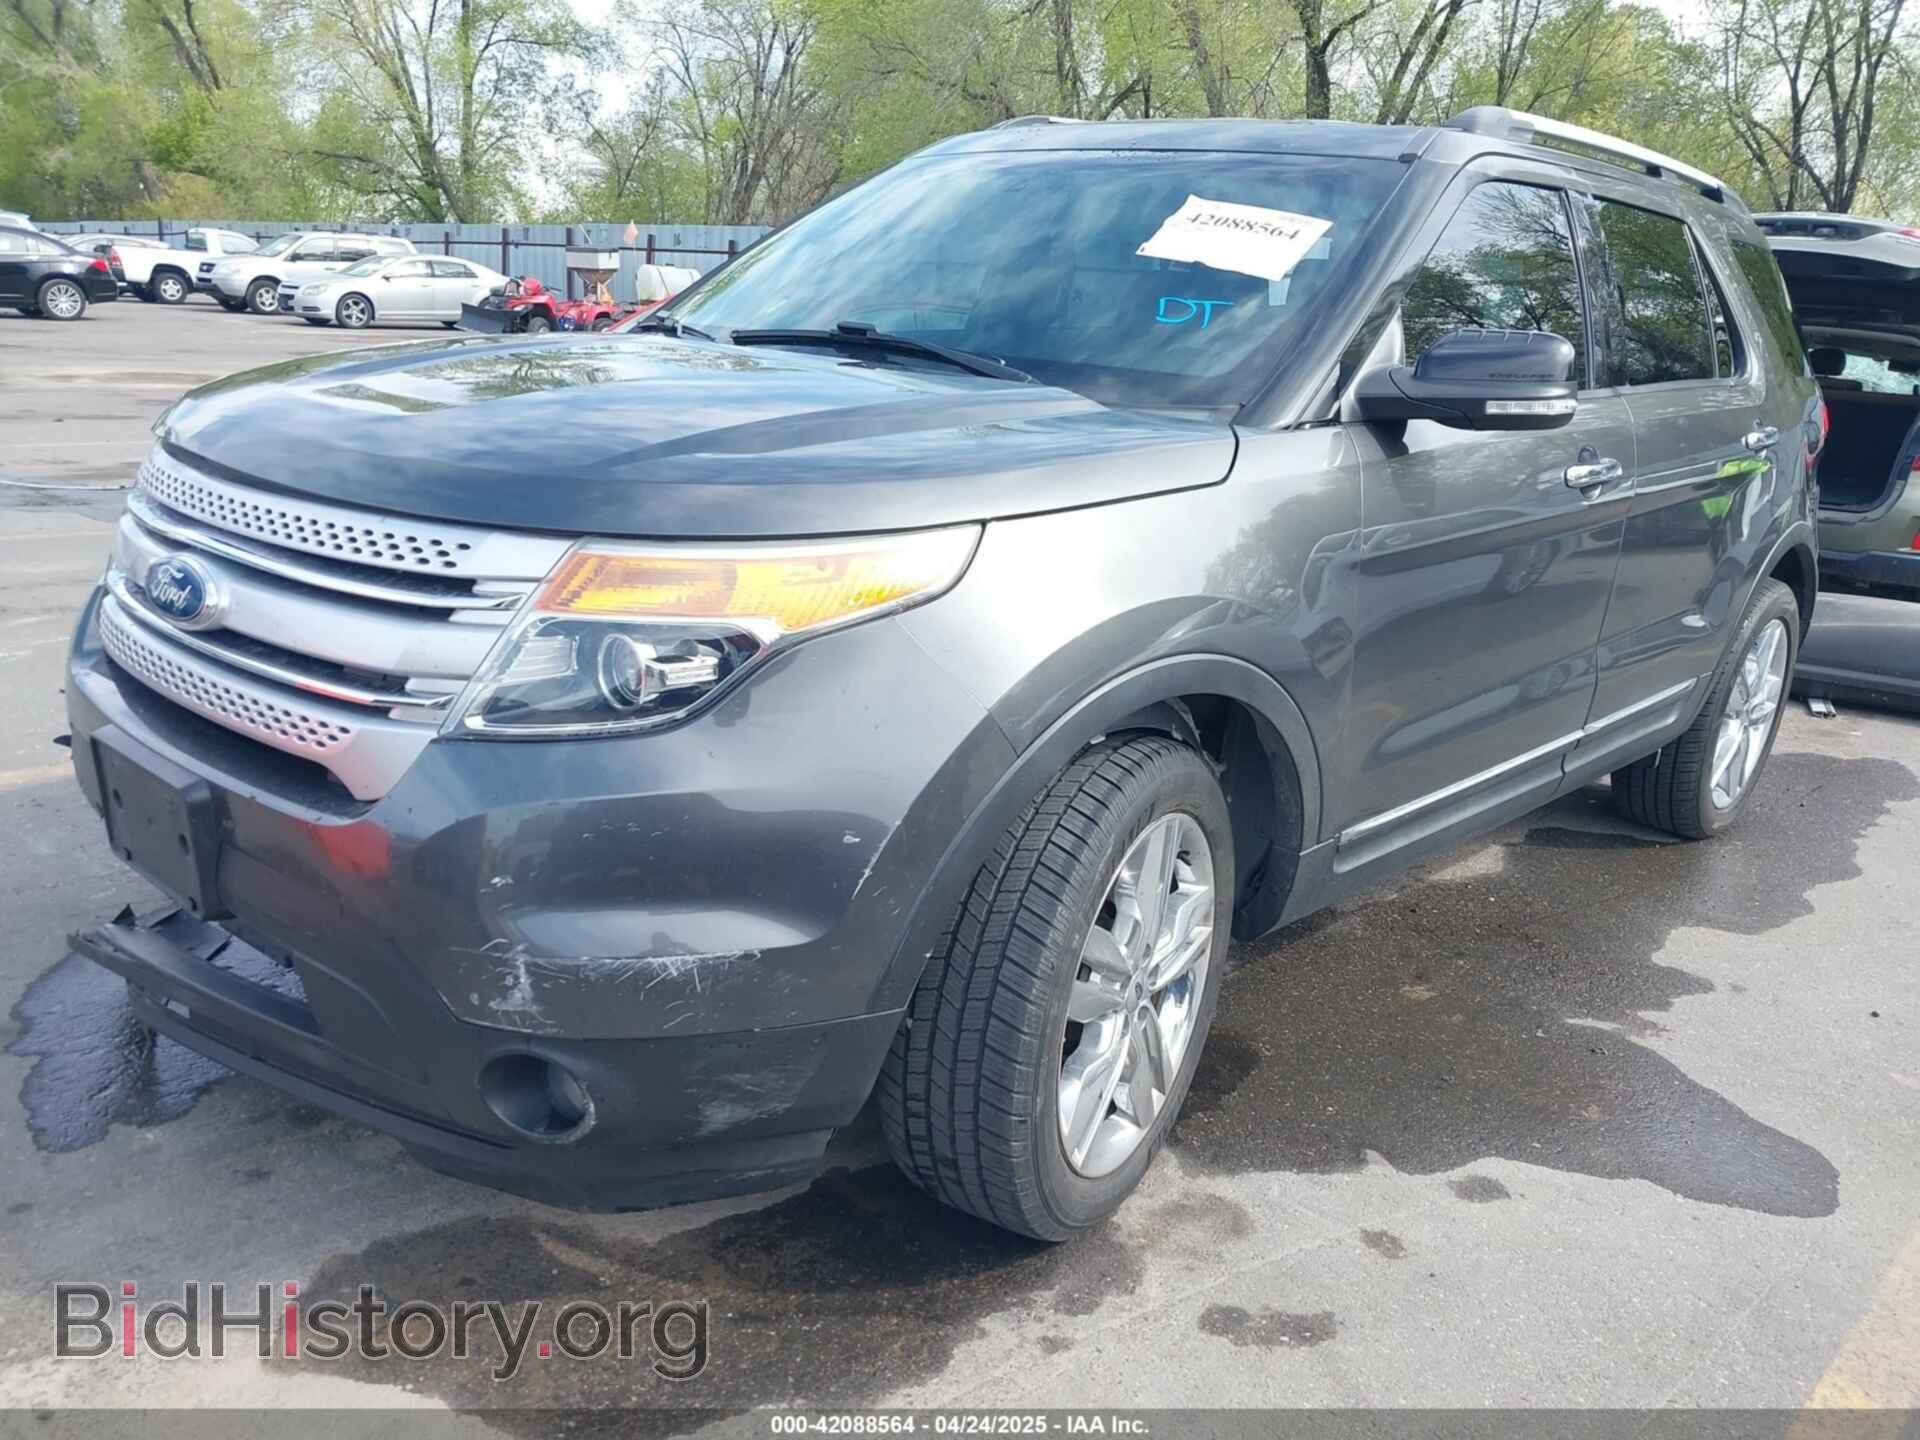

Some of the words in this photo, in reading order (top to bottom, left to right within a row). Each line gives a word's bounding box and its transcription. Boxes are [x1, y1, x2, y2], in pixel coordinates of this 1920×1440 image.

[1186, 211, 1302, 241] 42088564
[1155, 296, 1235, 329] DT
[149, 564, 193, 611] Ford
